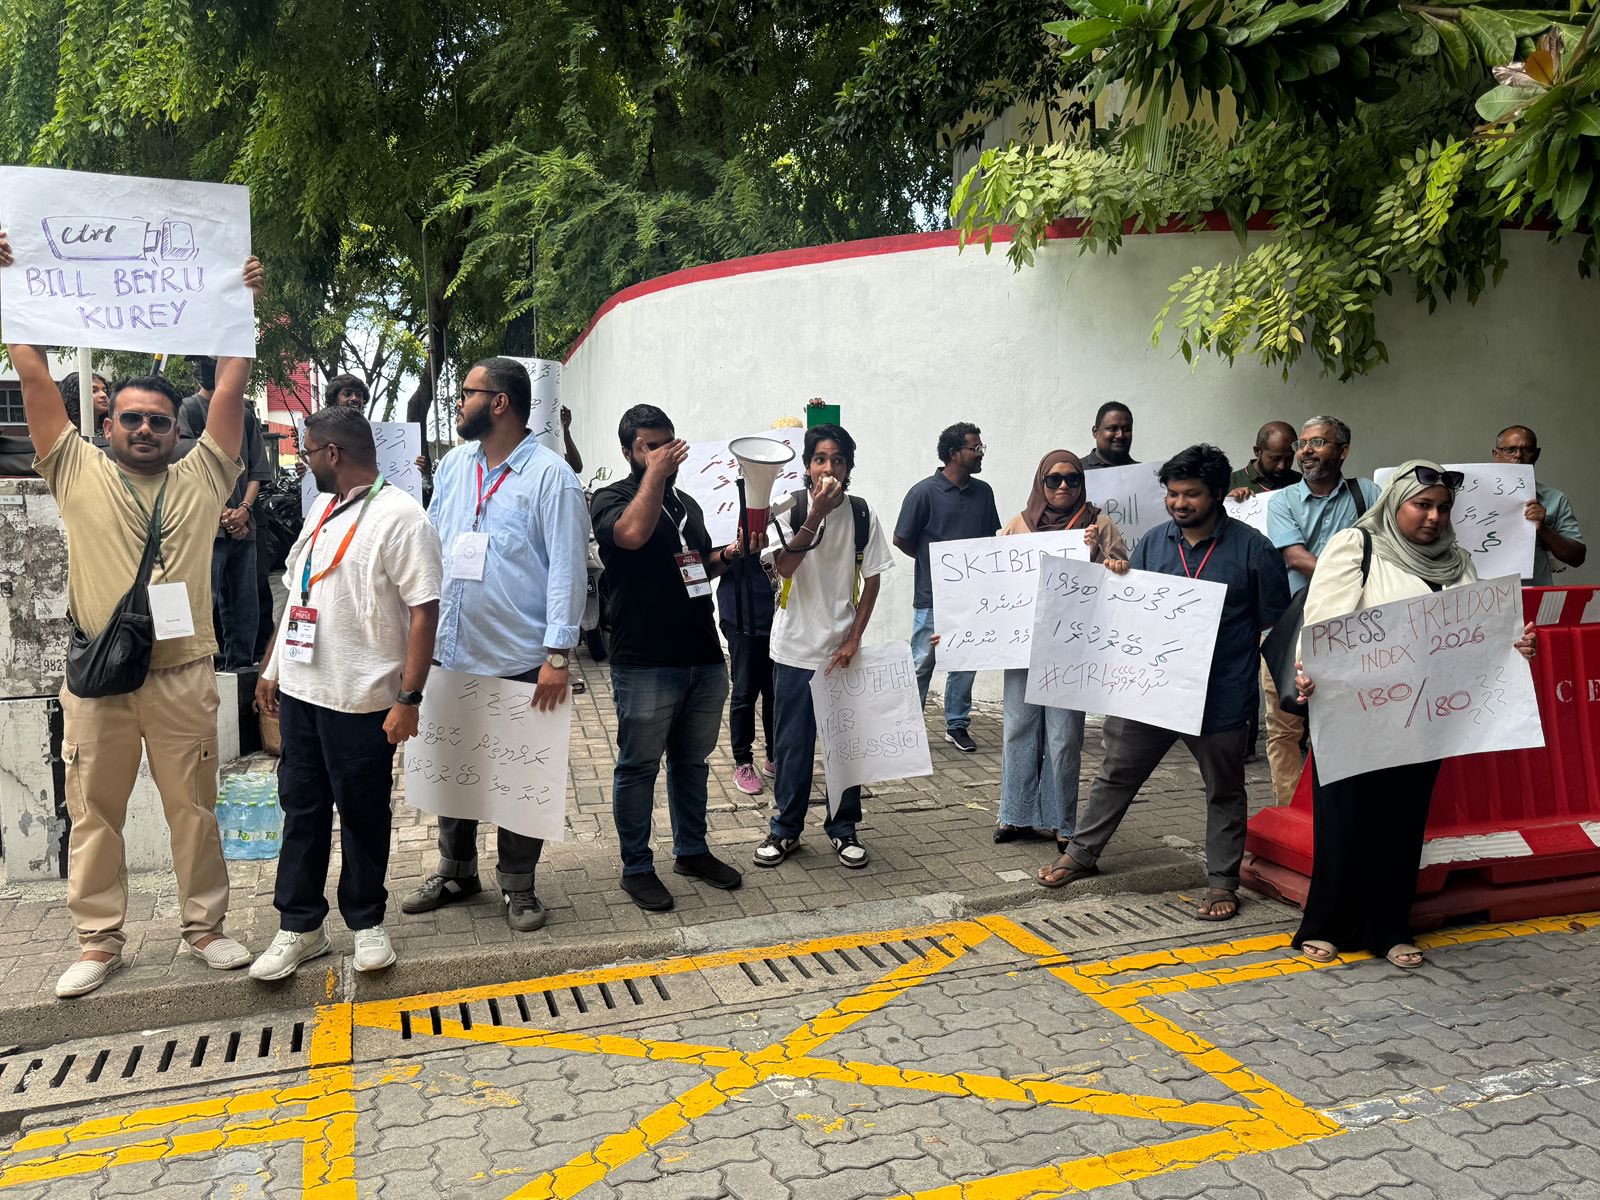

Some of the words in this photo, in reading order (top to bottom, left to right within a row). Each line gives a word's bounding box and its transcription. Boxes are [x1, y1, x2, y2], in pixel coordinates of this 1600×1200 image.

[25, 266, 97, 298] BILL
[113, 266, 206, 298] BEYRU
[76, 299, 188, 330] KUREY
[1106, 493, 1139, 527] Bill
[941, 548, 1077, 582] SKIBI
[1311, 609, 1386, 657] PRESS
[1407, 583, 1518, 640] FREEDOM
[1361, 644, 1416, 673] INDEX
[1430, 624, 1486, 656] 2026
[1357, 676, 1472, 730] 180/180
